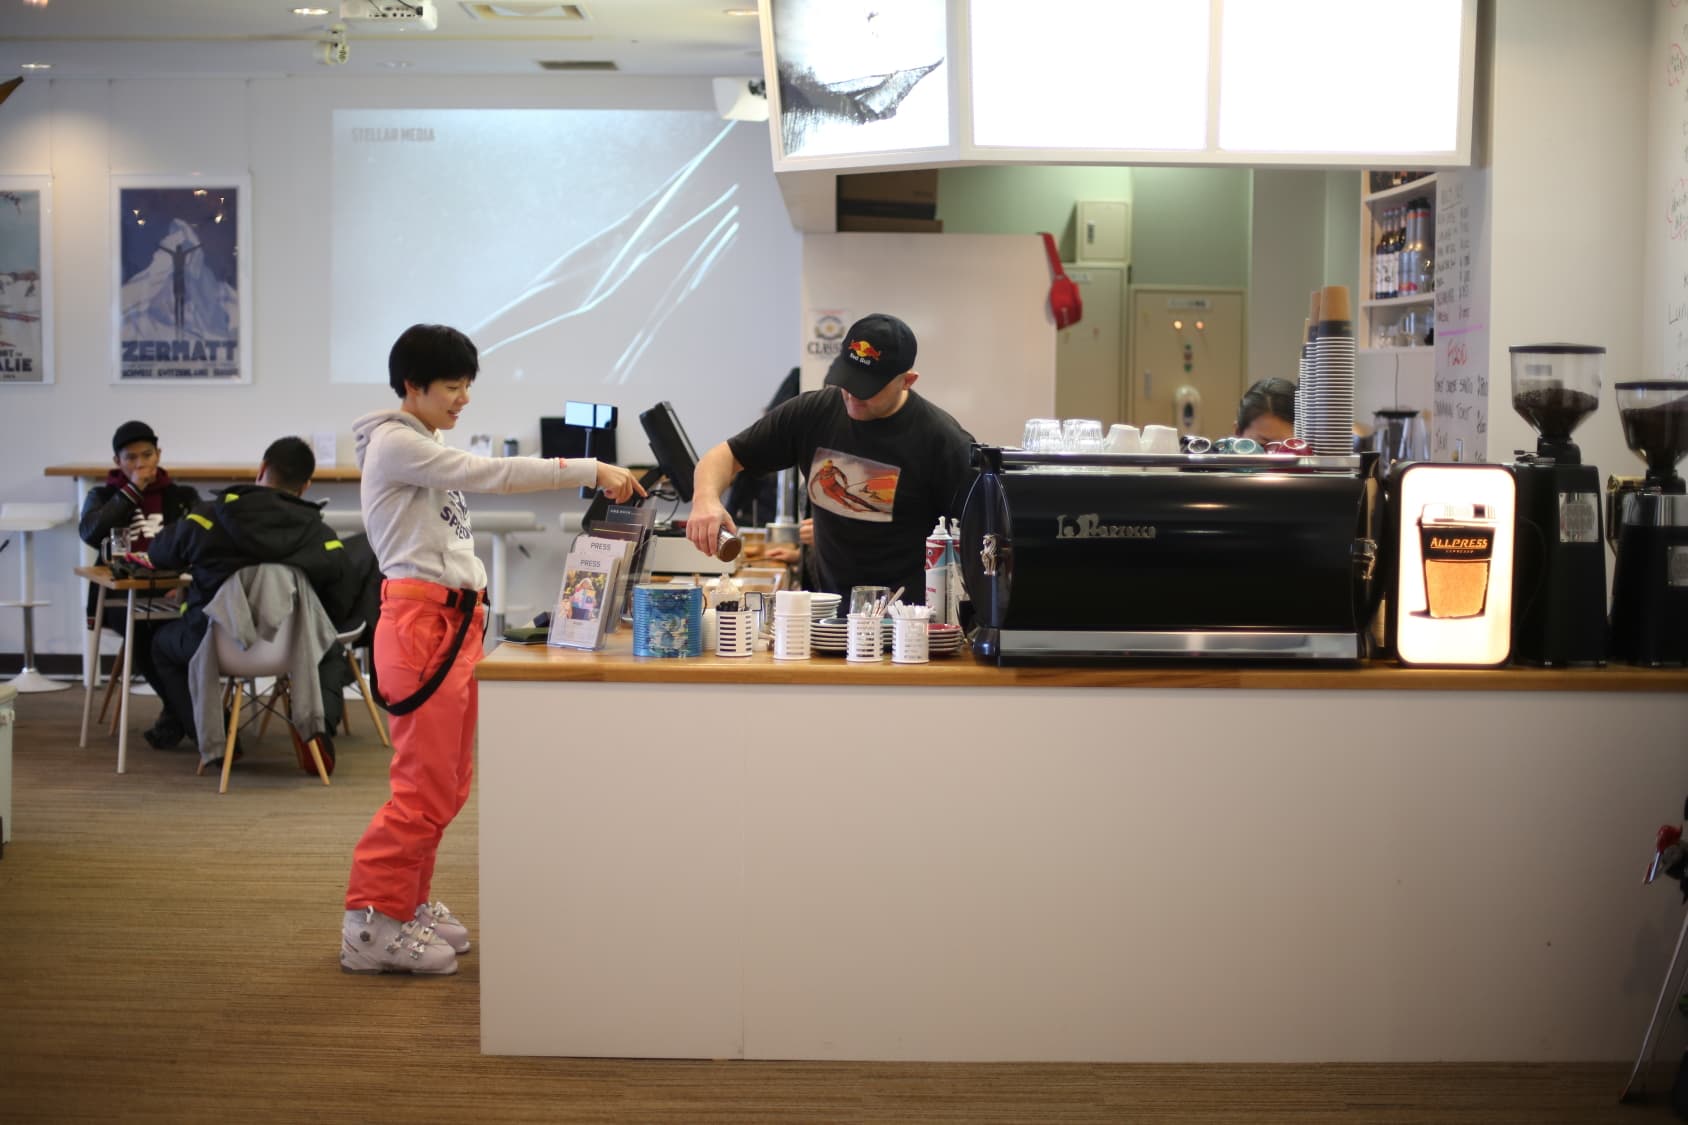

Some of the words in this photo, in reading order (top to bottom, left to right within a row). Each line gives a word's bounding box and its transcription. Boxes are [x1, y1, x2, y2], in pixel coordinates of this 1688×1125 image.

[400, 127, 435, 142] MEDIA
[121, 340, 239, 362] ZERMATT
[850, 353, 859, 361] Red
[859, 357, 871, 365] Bull
[590, 542, 612, 552] PRESS
[1430, 536, 1488, 549] ALLPRESS
[580, 559, 601, 569] PRESS
